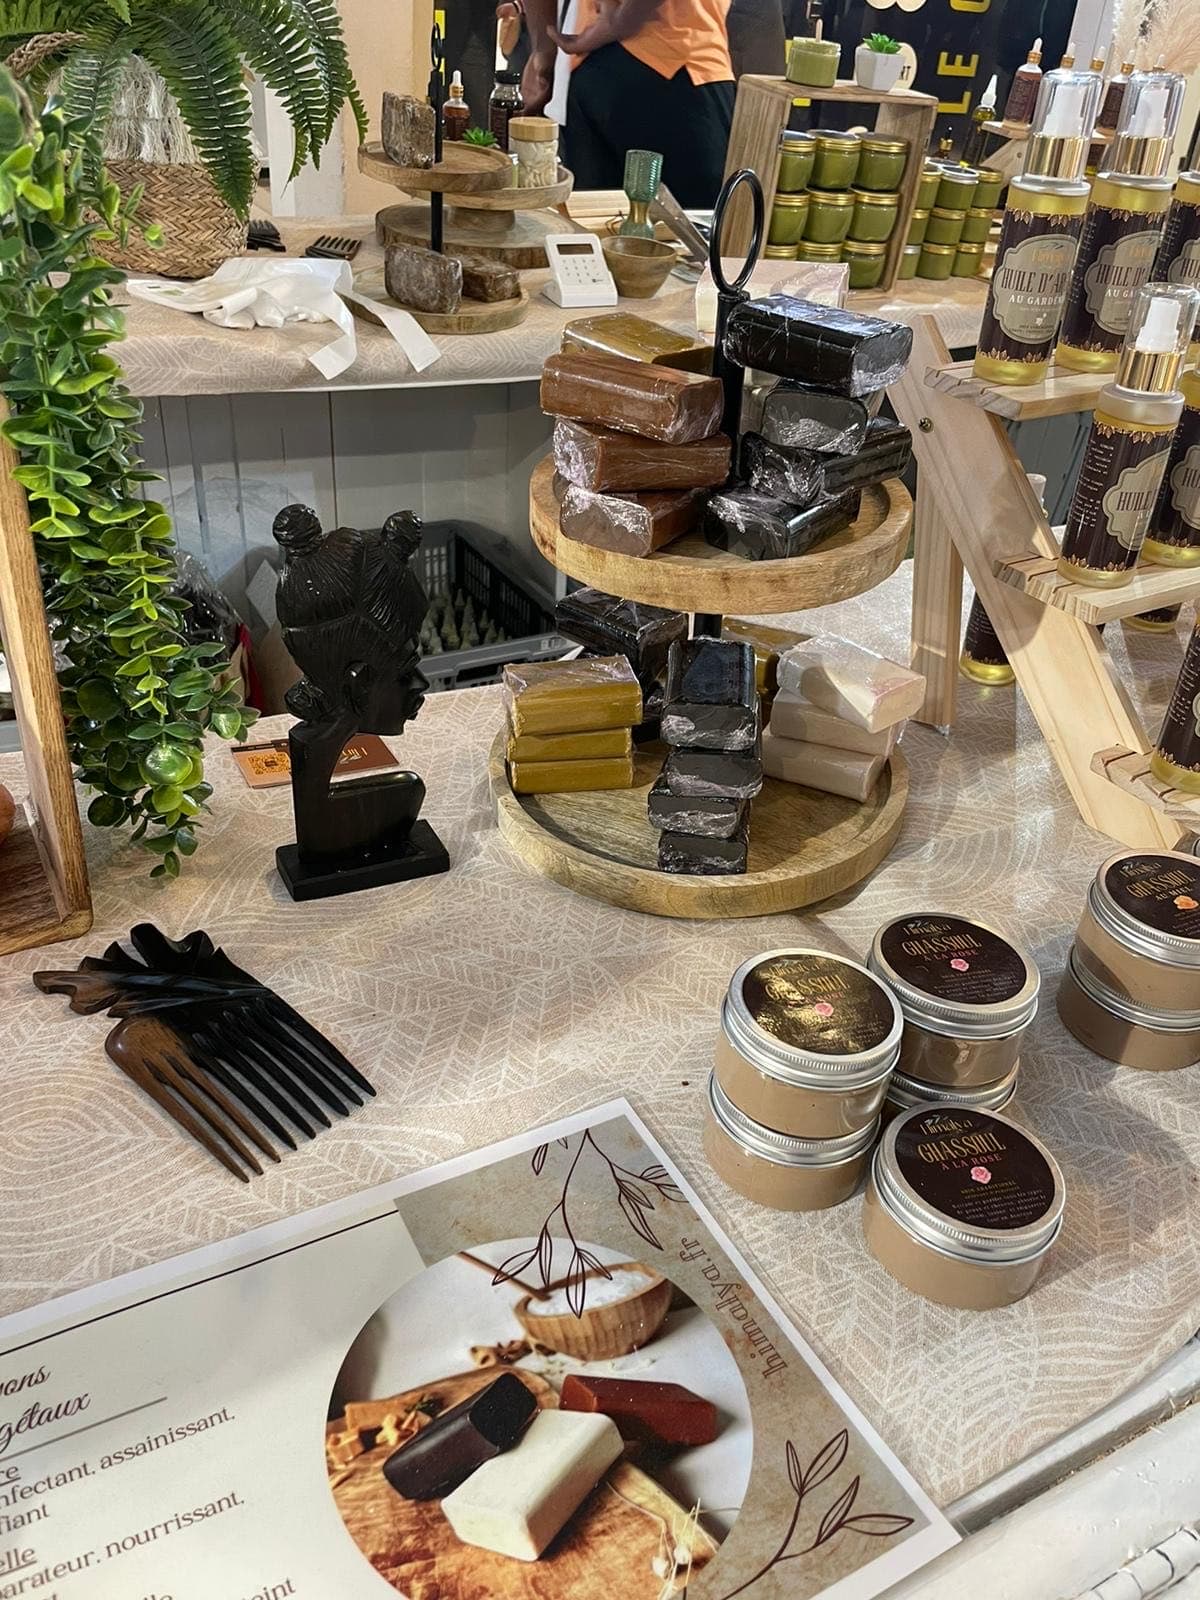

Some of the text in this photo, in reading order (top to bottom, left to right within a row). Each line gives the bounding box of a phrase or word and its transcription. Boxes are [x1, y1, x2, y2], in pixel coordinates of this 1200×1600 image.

[1001, 268, 1037, 293] HUILE
[1096, 263, 1133, 287] HUILE
[1008, 294, 1024, 304] AU
[1105, 288, 1121, 298] AU
[953, 1160, 969, 1170] LA
[971, 1153, 1003, 1167] ROSE
[679, 1237, 789, 1380] himalya.fr
